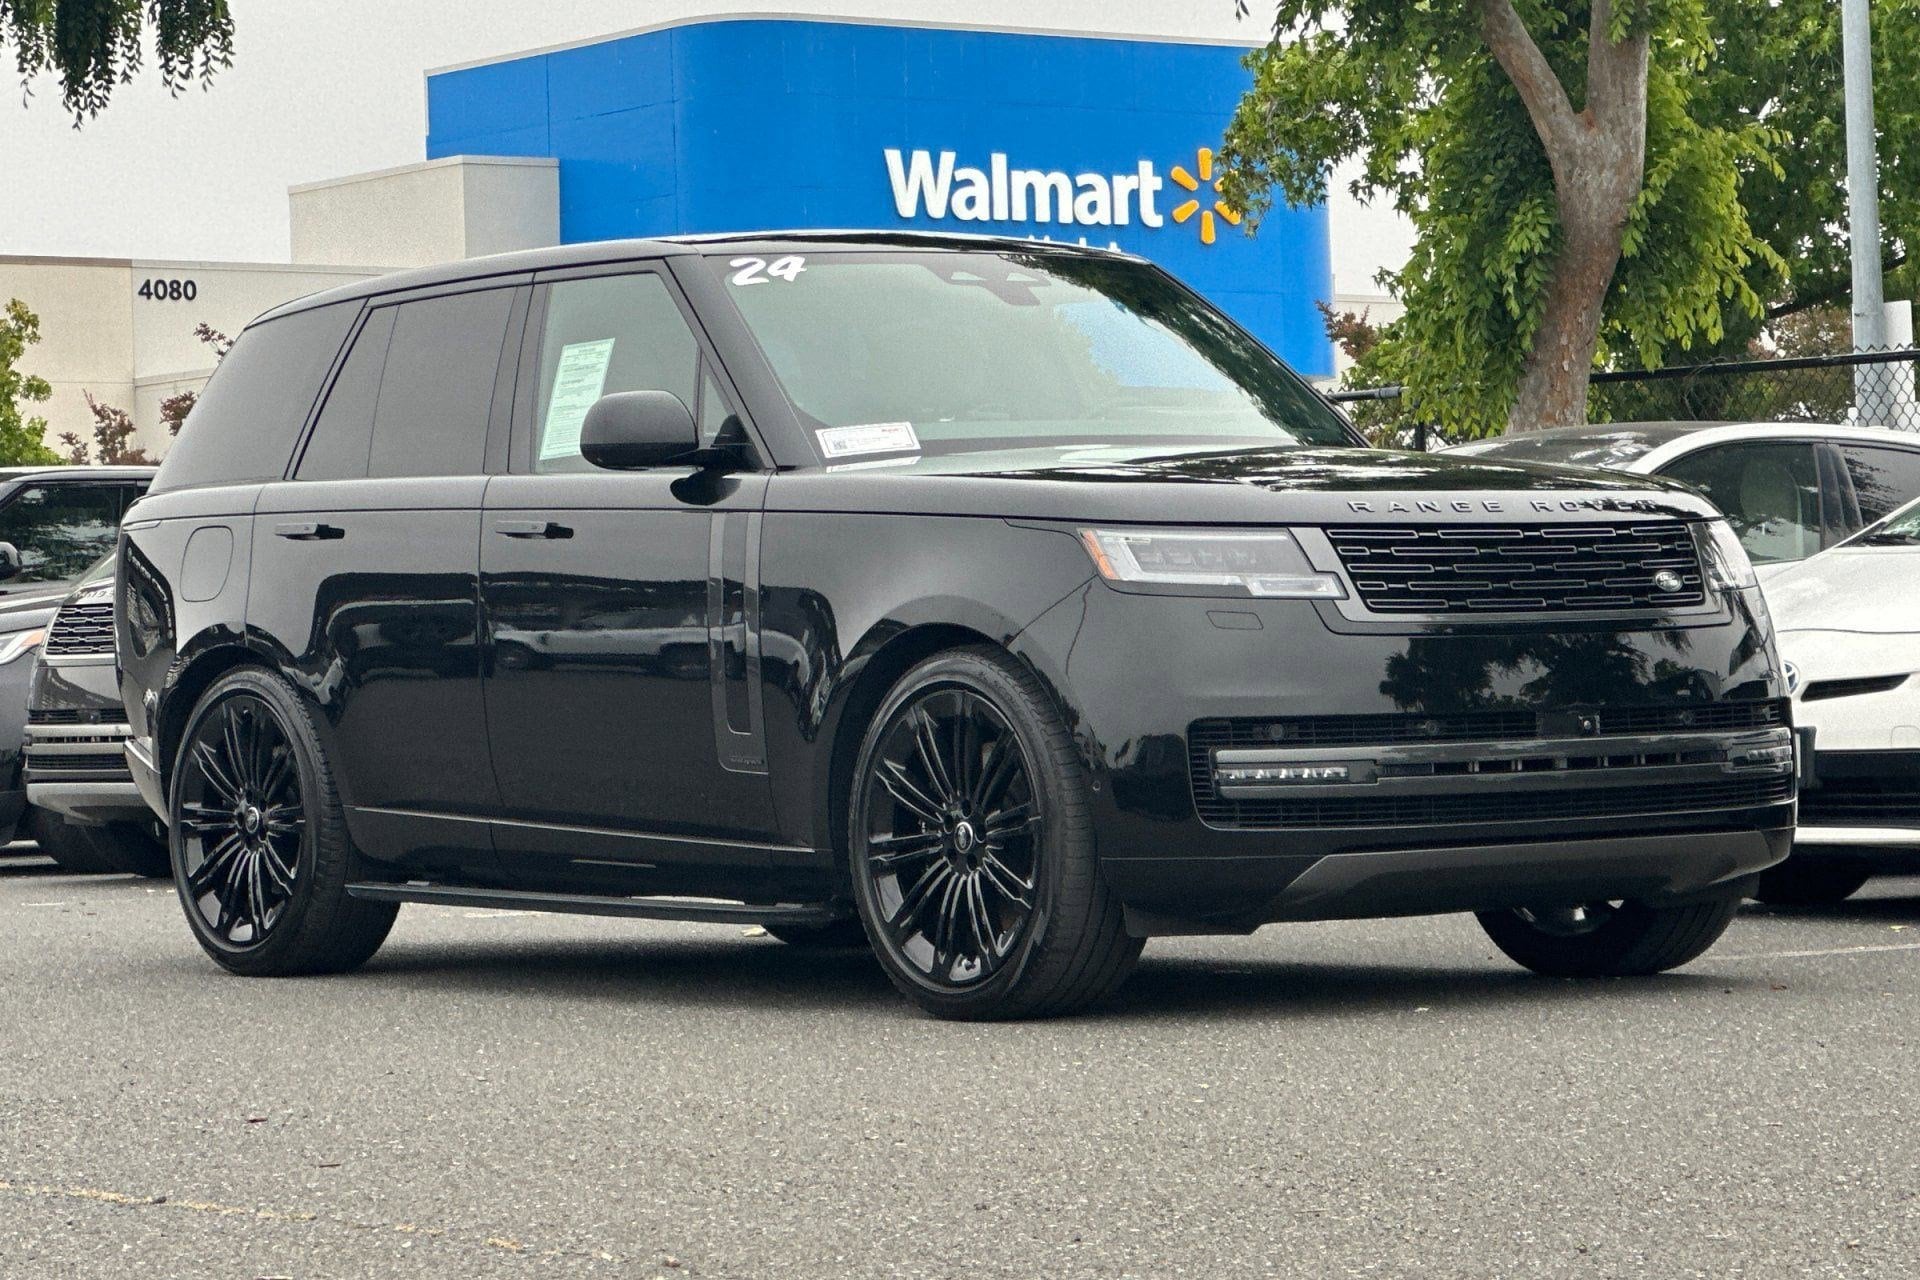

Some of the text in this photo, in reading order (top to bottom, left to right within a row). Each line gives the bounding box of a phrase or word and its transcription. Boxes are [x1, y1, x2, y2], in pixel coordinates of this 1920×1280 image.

[884, 148, 1163, 228] Walmart
[730, 256, 807, 286] 24
[138, 279, 197, 301] 4080
[1347, 499, 1656, 512] RANGE ROVER
